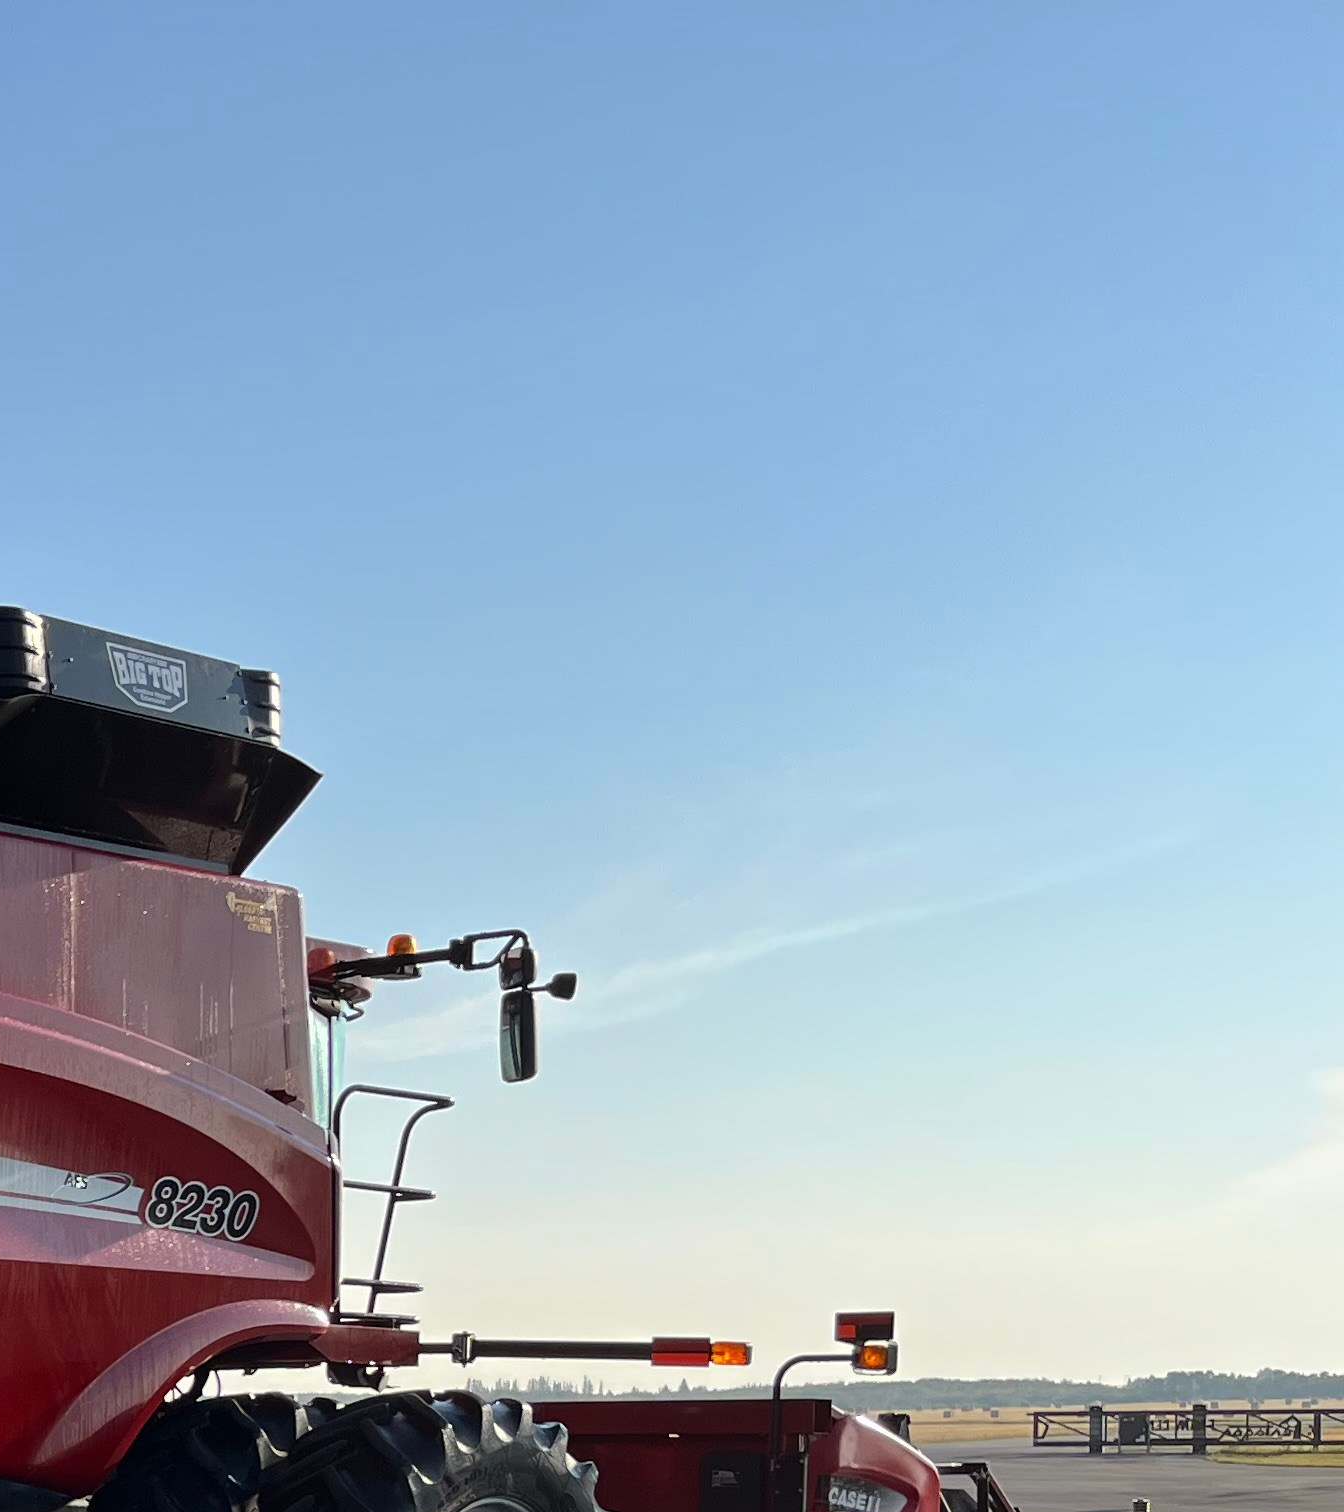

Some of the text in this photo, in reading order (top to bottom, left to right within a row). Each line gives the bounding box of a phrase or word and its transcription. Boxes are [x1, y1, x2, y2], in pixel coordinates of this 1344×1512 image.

[112, 651, 148, 686] BIG
[147, 664, 183, 699] TOP
[145, 1176, 260, 1242] 8230
[828, 1486, 867, 1511] CASE
